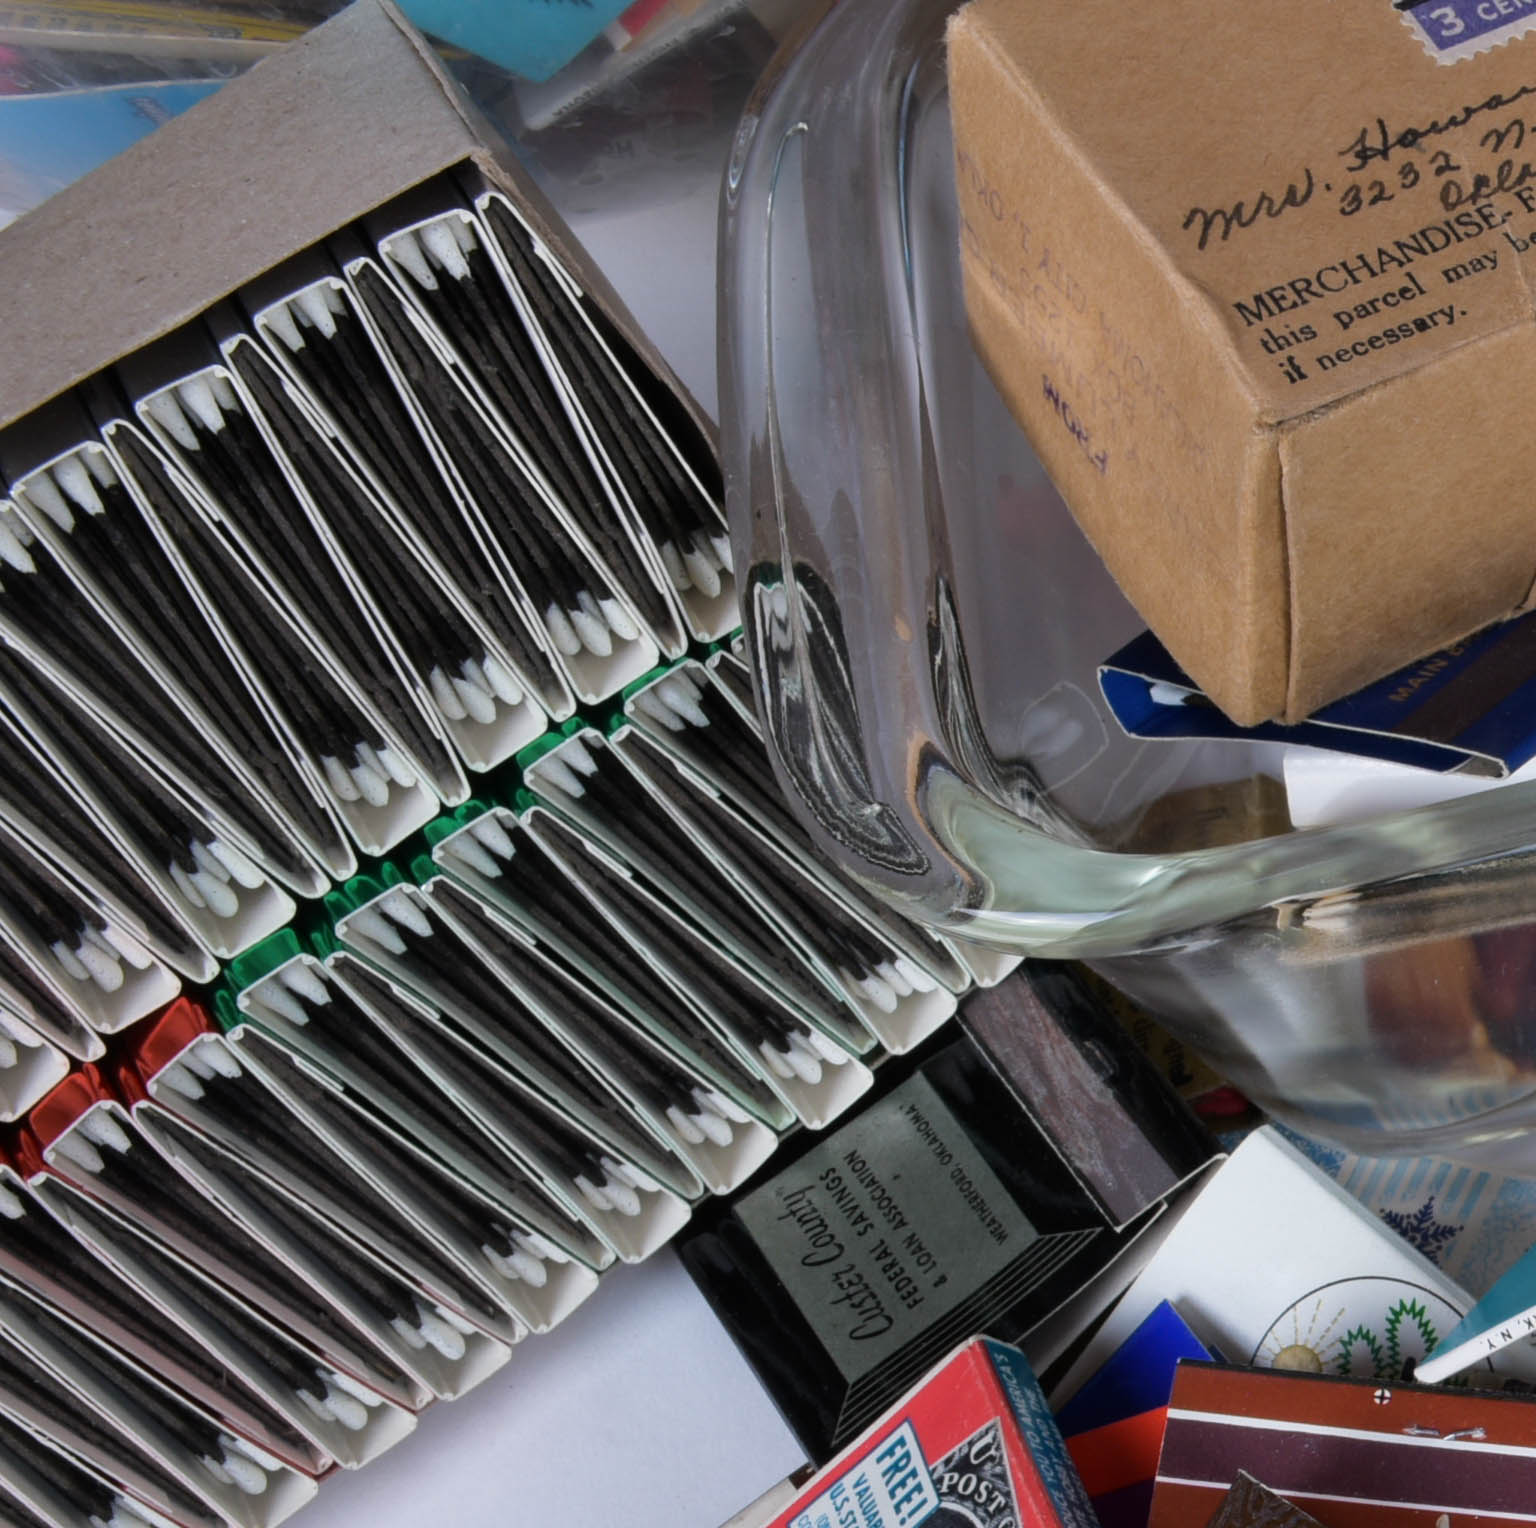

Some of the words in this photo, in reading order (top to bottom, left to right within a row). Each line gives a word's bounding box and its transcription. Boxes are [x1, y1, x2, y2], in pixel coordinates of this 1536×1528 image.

[1339, 149, 1462, 216] 3232
[1316, 303, 1469, 372] necessary.
[1333, 278, 1428, 331] parcel
[819, 1167, 875, 1238] SAVINGS
[843, 1149, 910, 1231] ASSOCIATION
[777, 1185, 845, 1268] County
[831, 1263, 894, 1341] Custer
[870, 1239, 925, 1310] FEDERAL
[875, 1434, 929, 1527] FREE!
[940, 1472, 1006, 1514] POST
